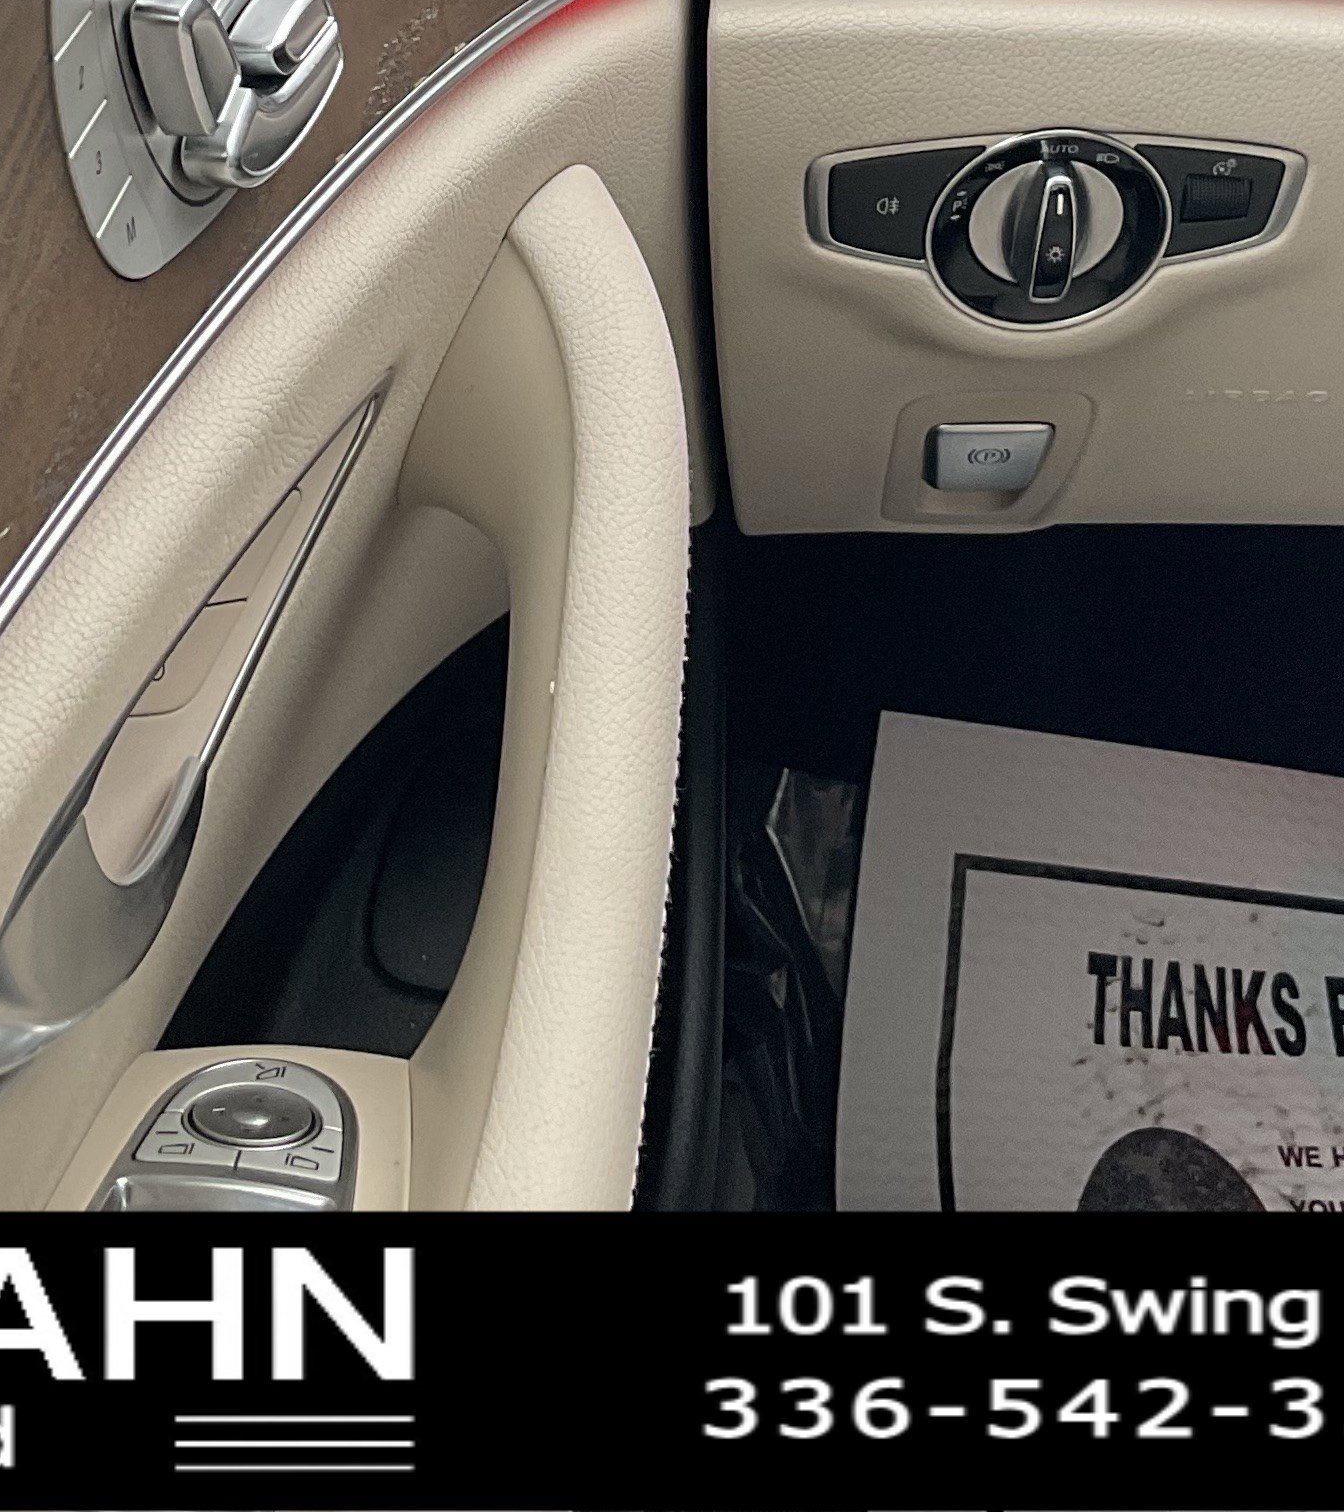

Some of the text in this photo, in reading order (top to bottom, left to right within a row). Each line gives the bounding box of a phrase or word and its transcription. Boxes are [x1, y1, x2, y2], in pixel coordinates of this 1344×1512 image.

[1040, 143, 1079, 155] AUTO
[1087, 951, 1307, 1057] THANKS
[1278, 1145, 1323, 1168] WE
